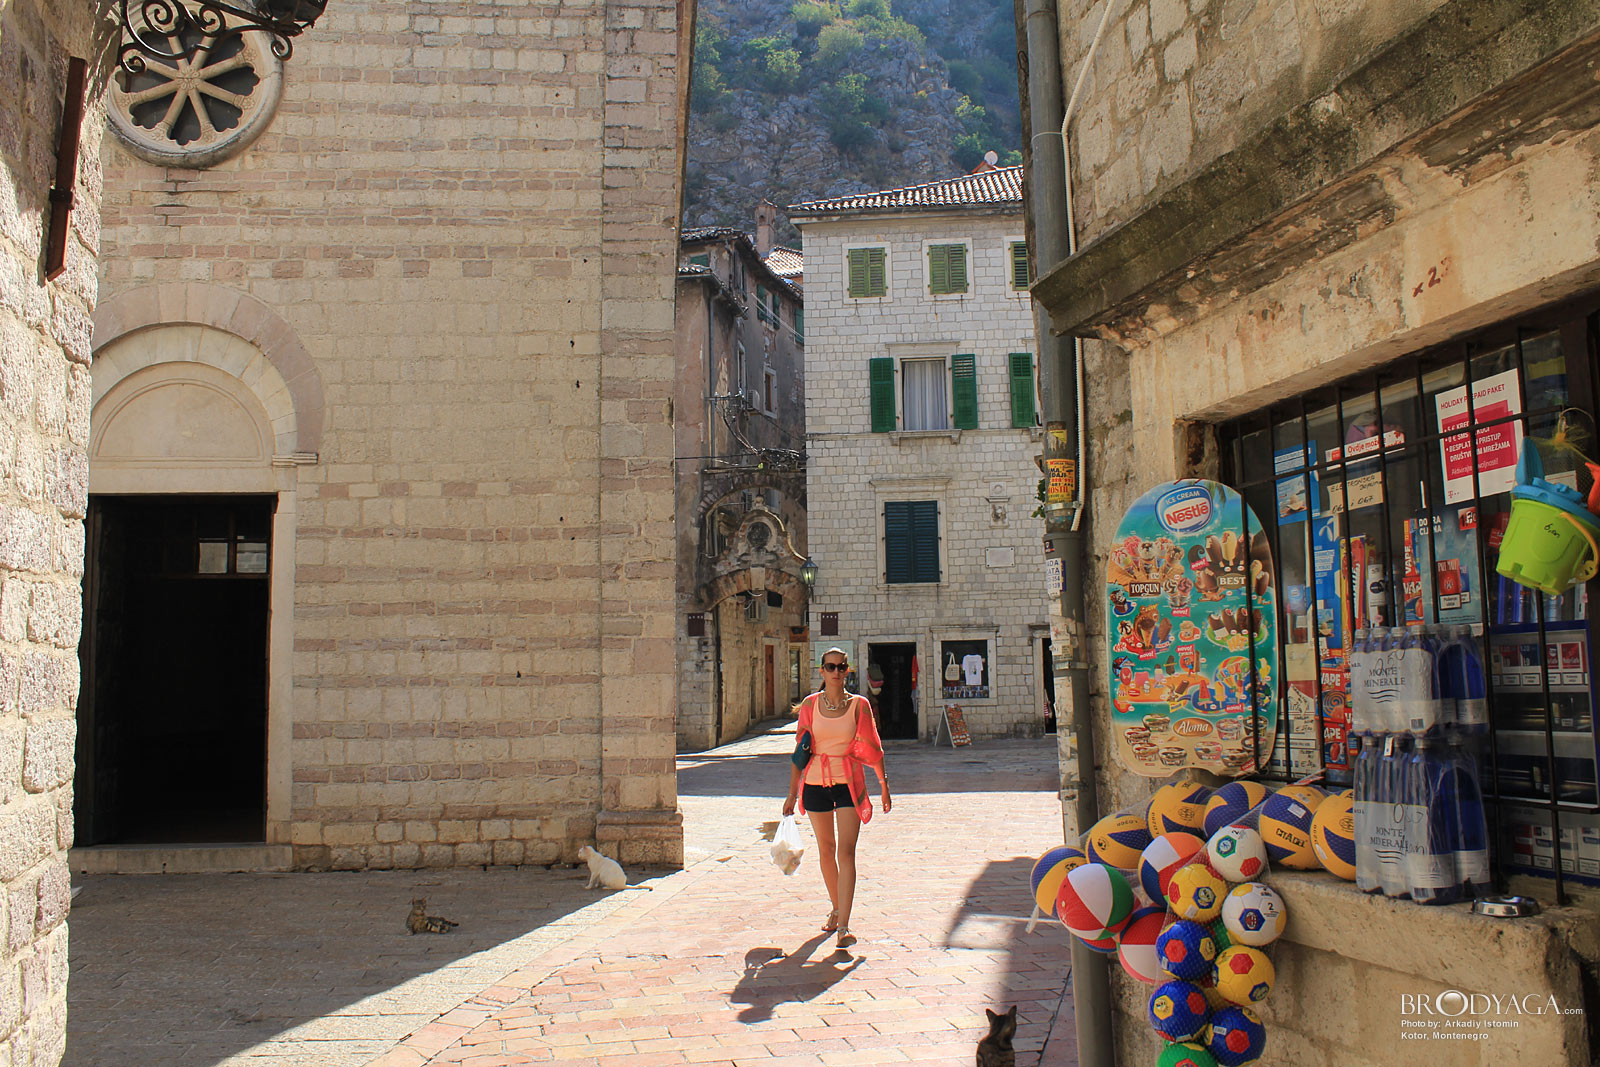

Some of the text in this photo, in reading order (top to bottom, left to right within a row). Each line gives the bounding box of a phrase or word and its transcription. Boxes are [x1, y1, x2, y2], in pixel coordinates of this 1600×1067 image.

[1440, 383, 1505, 410] HOLIDAY PPAID PAKET
[1479, 432, 1502, 445] PRISTUP
[1165, 490, 1201, 505] ICE CREAM
[1404, 545, 1412, 574] VAPE
[1219, 576, 1246, 585] BEST
[1363, 677, 1406, 688] MINERALE
[1176, 721, 1209, 734] Aloma
[1323, 727, 1342, 740] APE
[1267, 902, 1275, 911] 2
